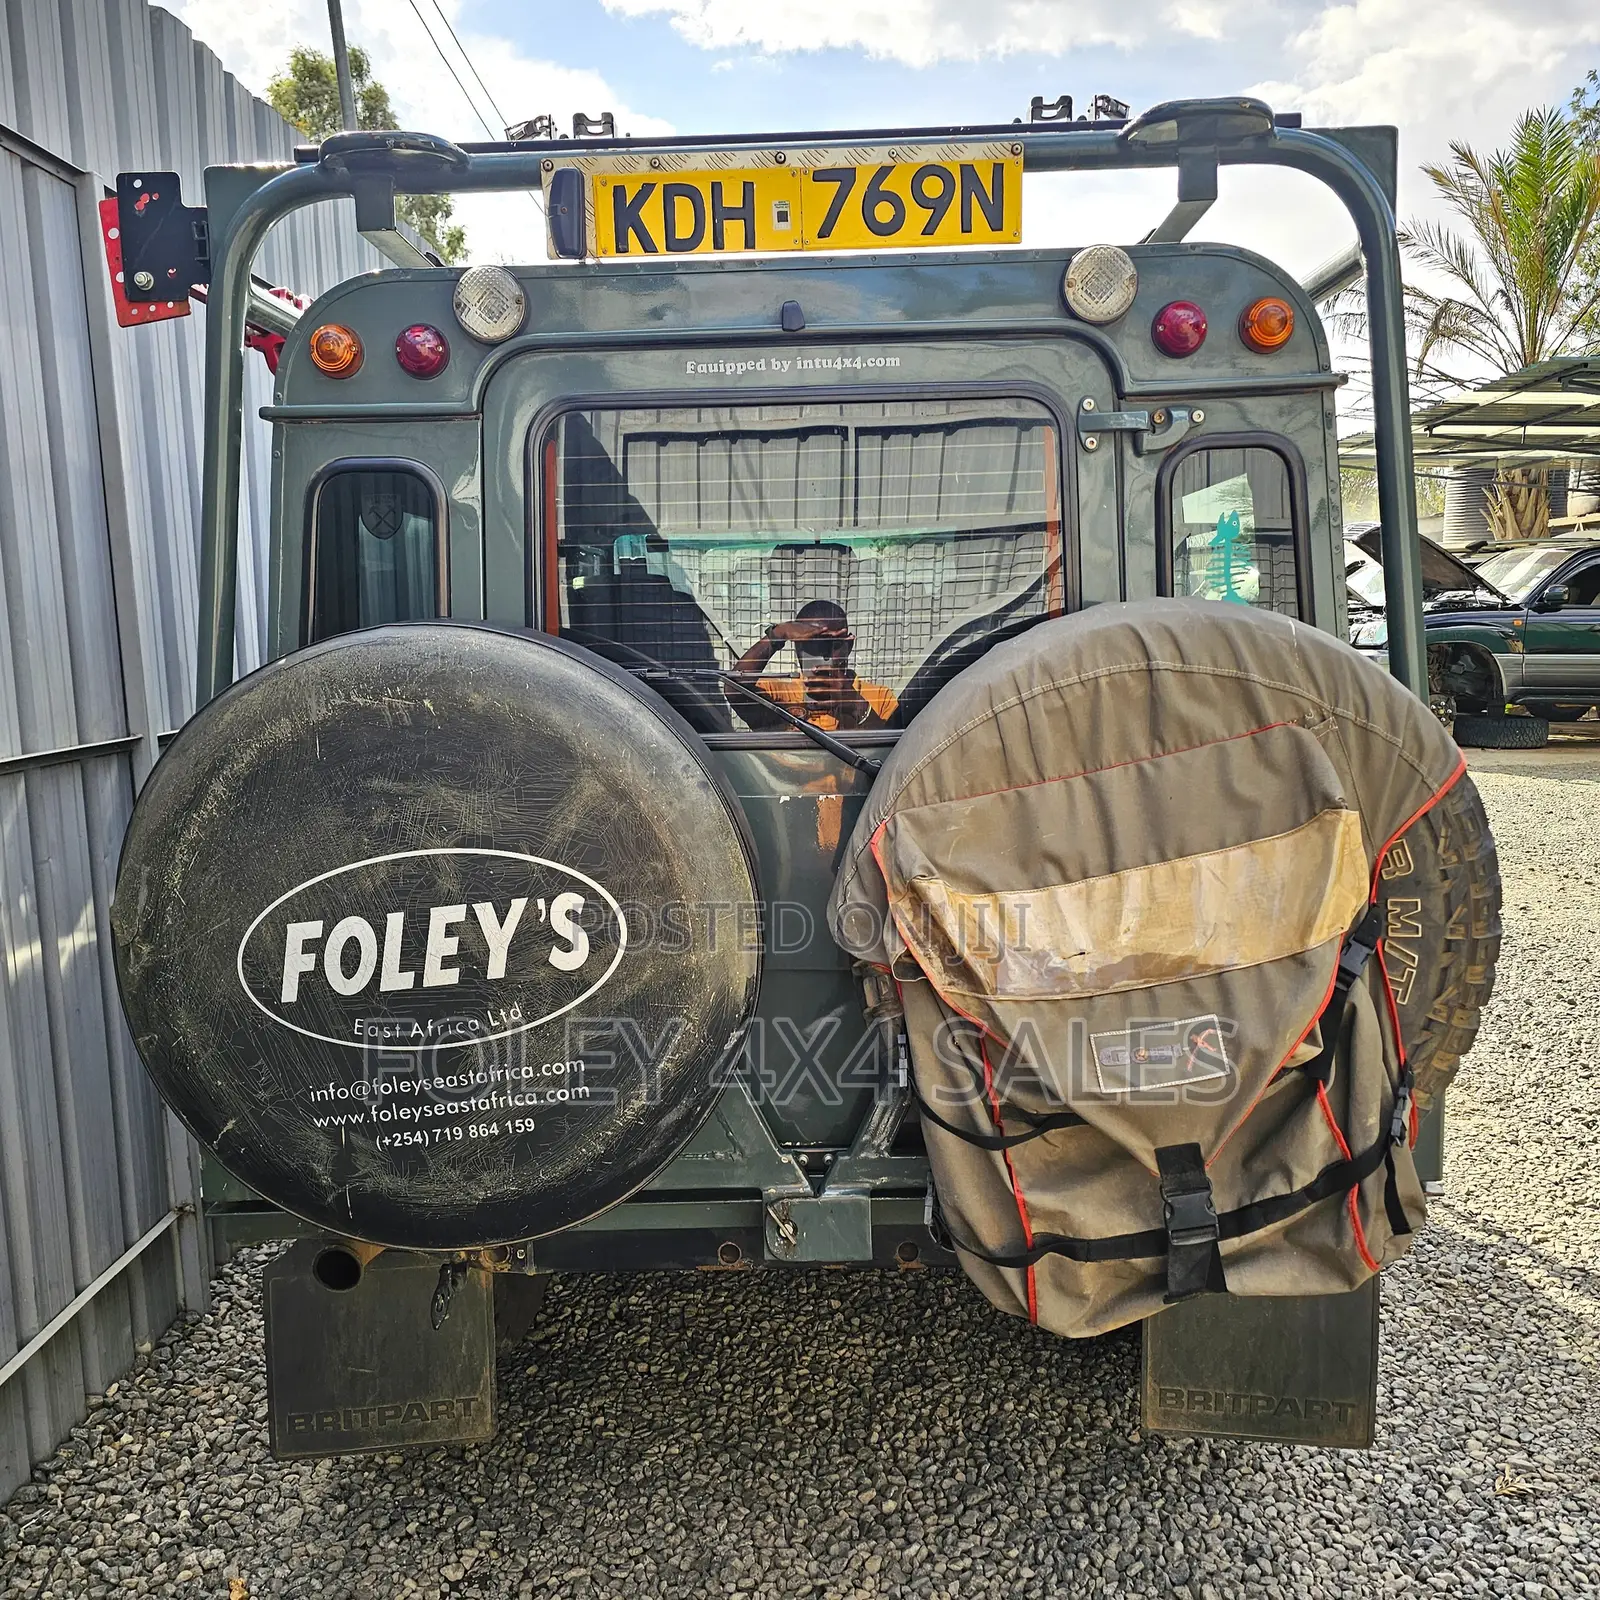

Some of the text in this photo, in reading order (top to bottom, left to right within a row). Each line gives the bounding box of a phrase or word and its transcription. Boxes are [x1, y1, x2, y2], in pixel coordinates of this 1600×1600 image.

[613, 163, 1005, 253] KDH 769N
[770, 358, 792, 372] by
[796, 355, 901, 370] intu4x4.com
[280, 892, 590, 1003] FOLEY'S
[353, 1018, 401, 1038] East
[410, 1017, 480, 1038] Africa
[309, 1059, 586, 1103] info@foleyseastafrica.com
[312, 1083, 591, 1128] www.foleyseastafrica.com
[376, 1117, 536, 1151] (+254) 719 864 159
[286, 1396, 479, 1436] BRITPART
[1158, 1387, 1357, 1424] BRITPART
